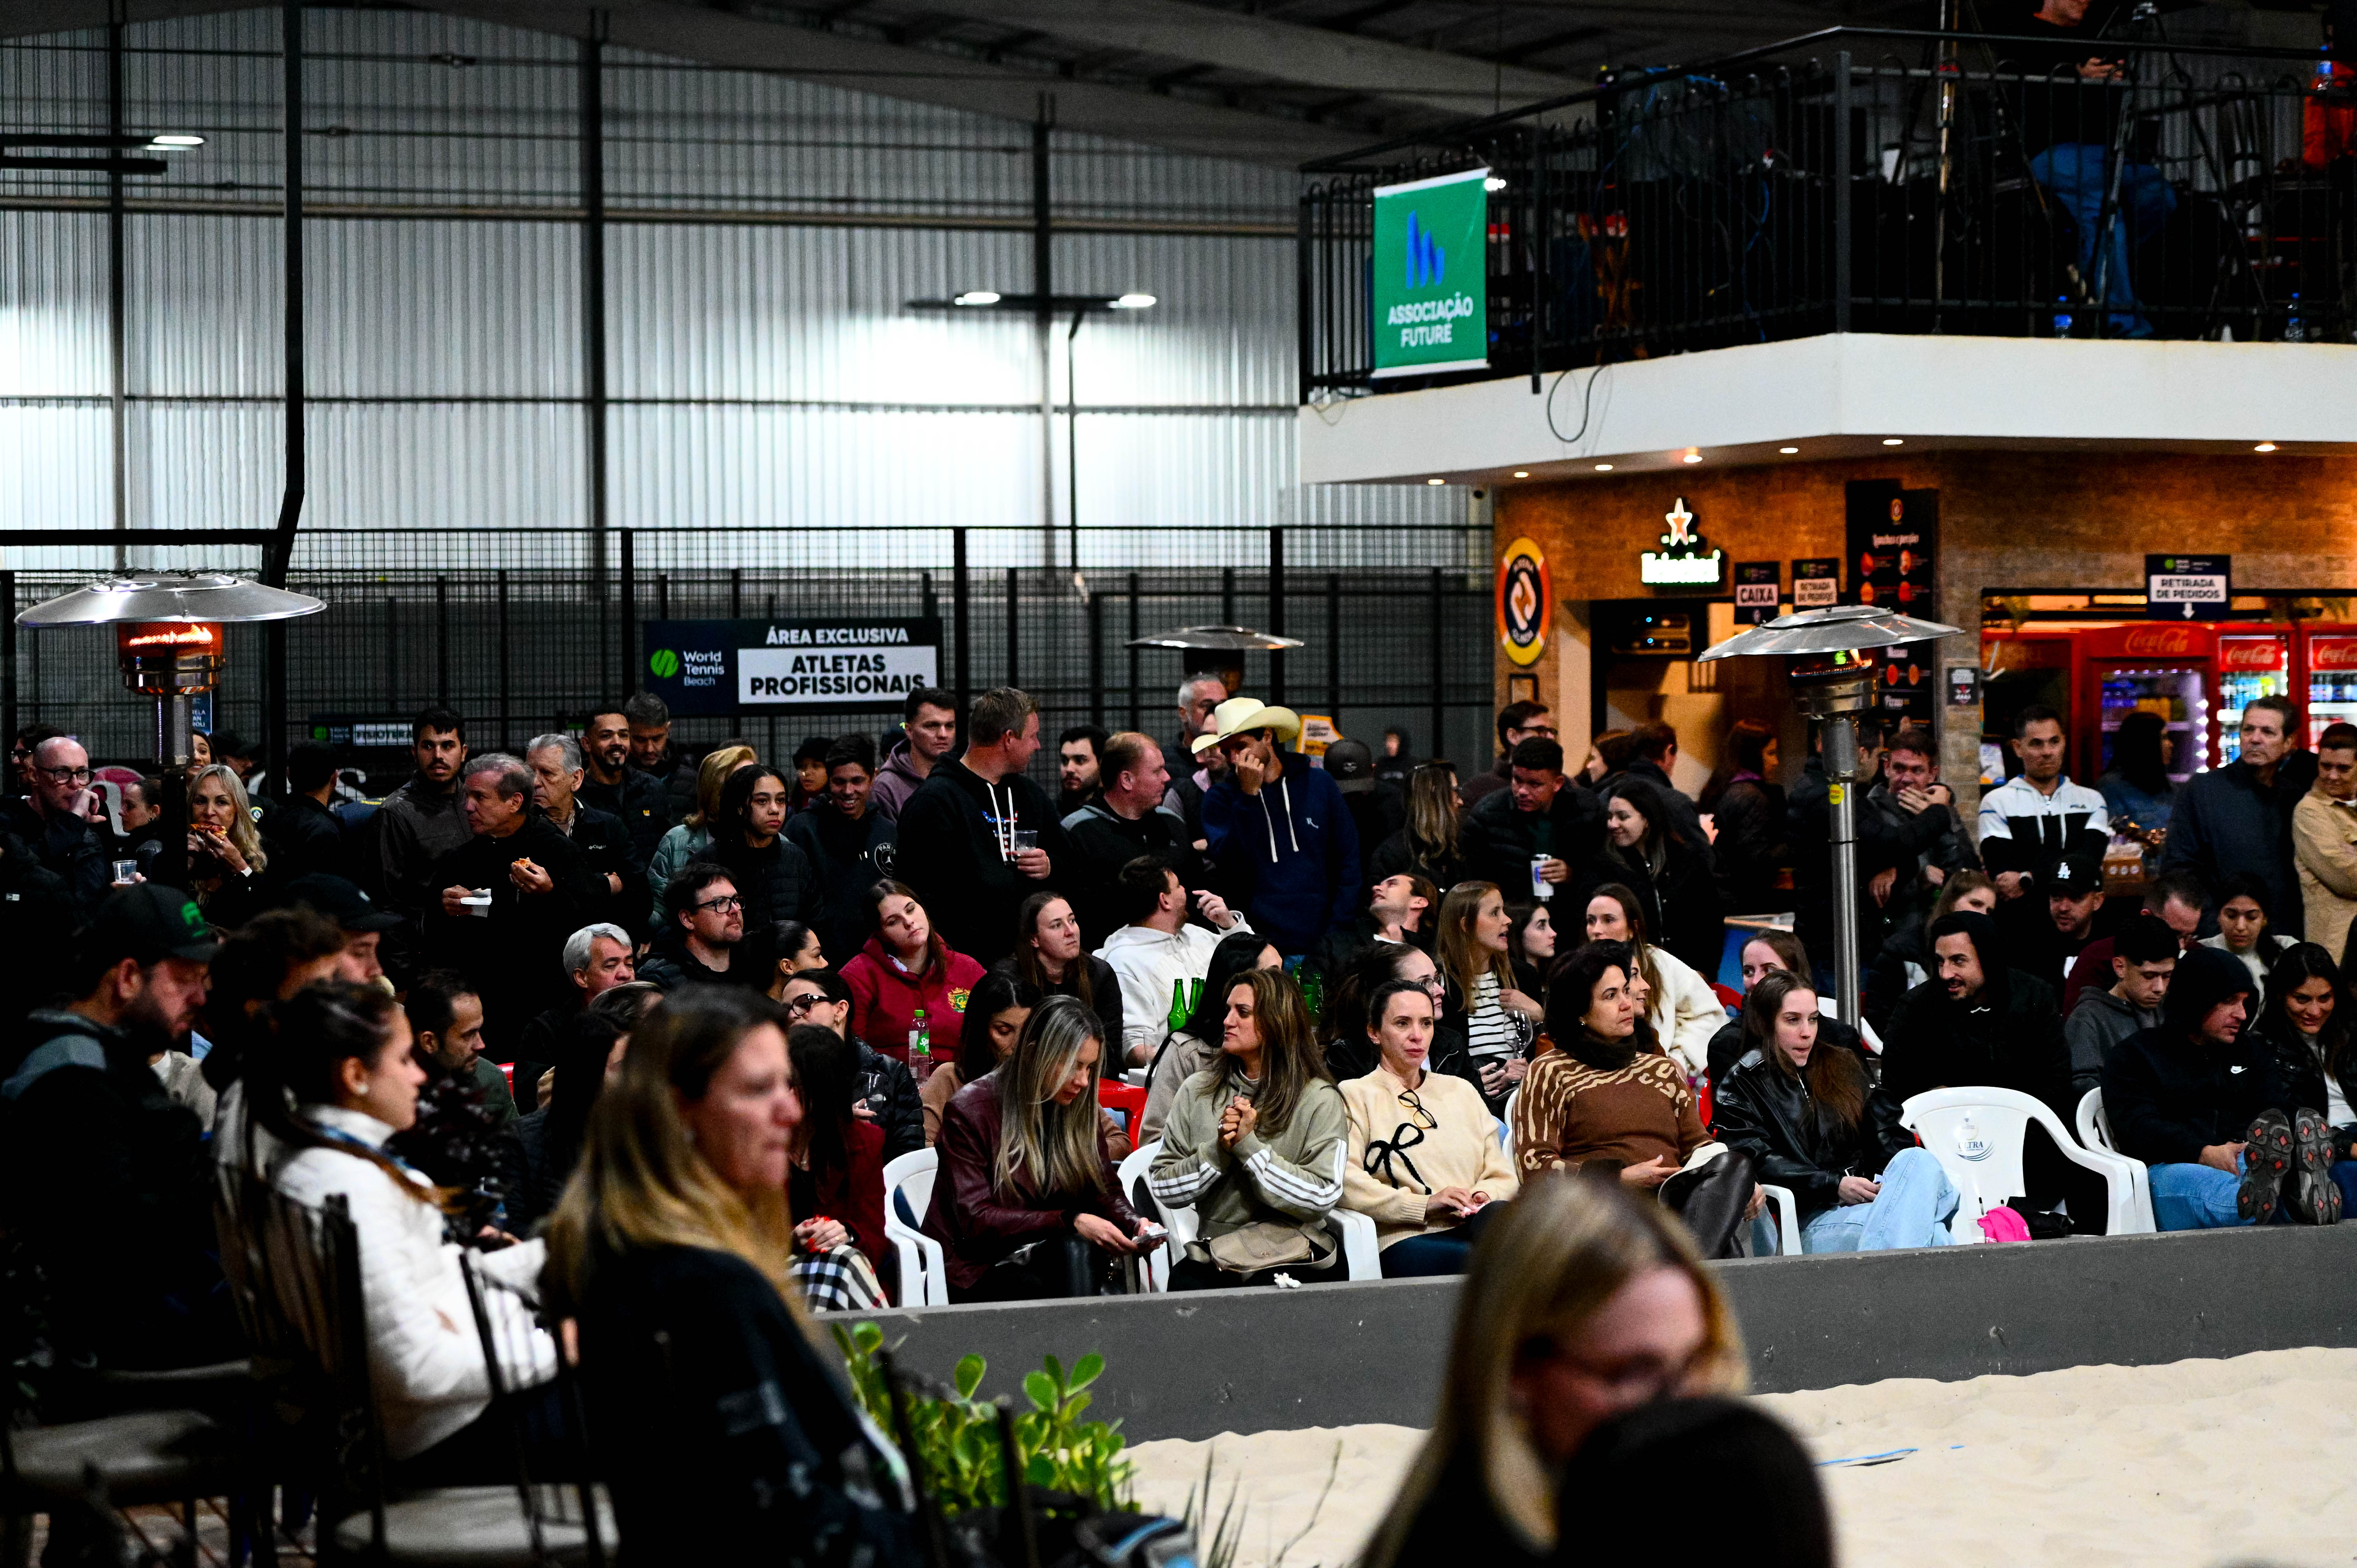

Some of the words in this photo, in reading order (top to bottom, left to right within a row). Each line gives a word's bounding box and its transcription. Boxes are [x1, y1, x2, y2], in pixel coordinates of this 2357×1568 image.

[1388, 291, 1474, 325] ASSOCIAÇÃO
[1400, 323, 1453, 347] FUTURE
[2161, 579, 2215, 587] RETIRADA
[1741, 588, 1774, 603] CAIXA
[2157, 590, 2169, 598] DE
[2173, 590, 2220, 599] PEDIDOS
[766, 626, 812, 645] ÁREA
[815, 627, 909, 644] EXCLUSIVA
[683, 650, 722, 662] World
[684, 662, 725, 675] Tennis
[792, 654, 886, 674] ATLETAS
[684, 676, 716, 686] Beach
[751, 674, 925, 695] PROFISSIONAIS
